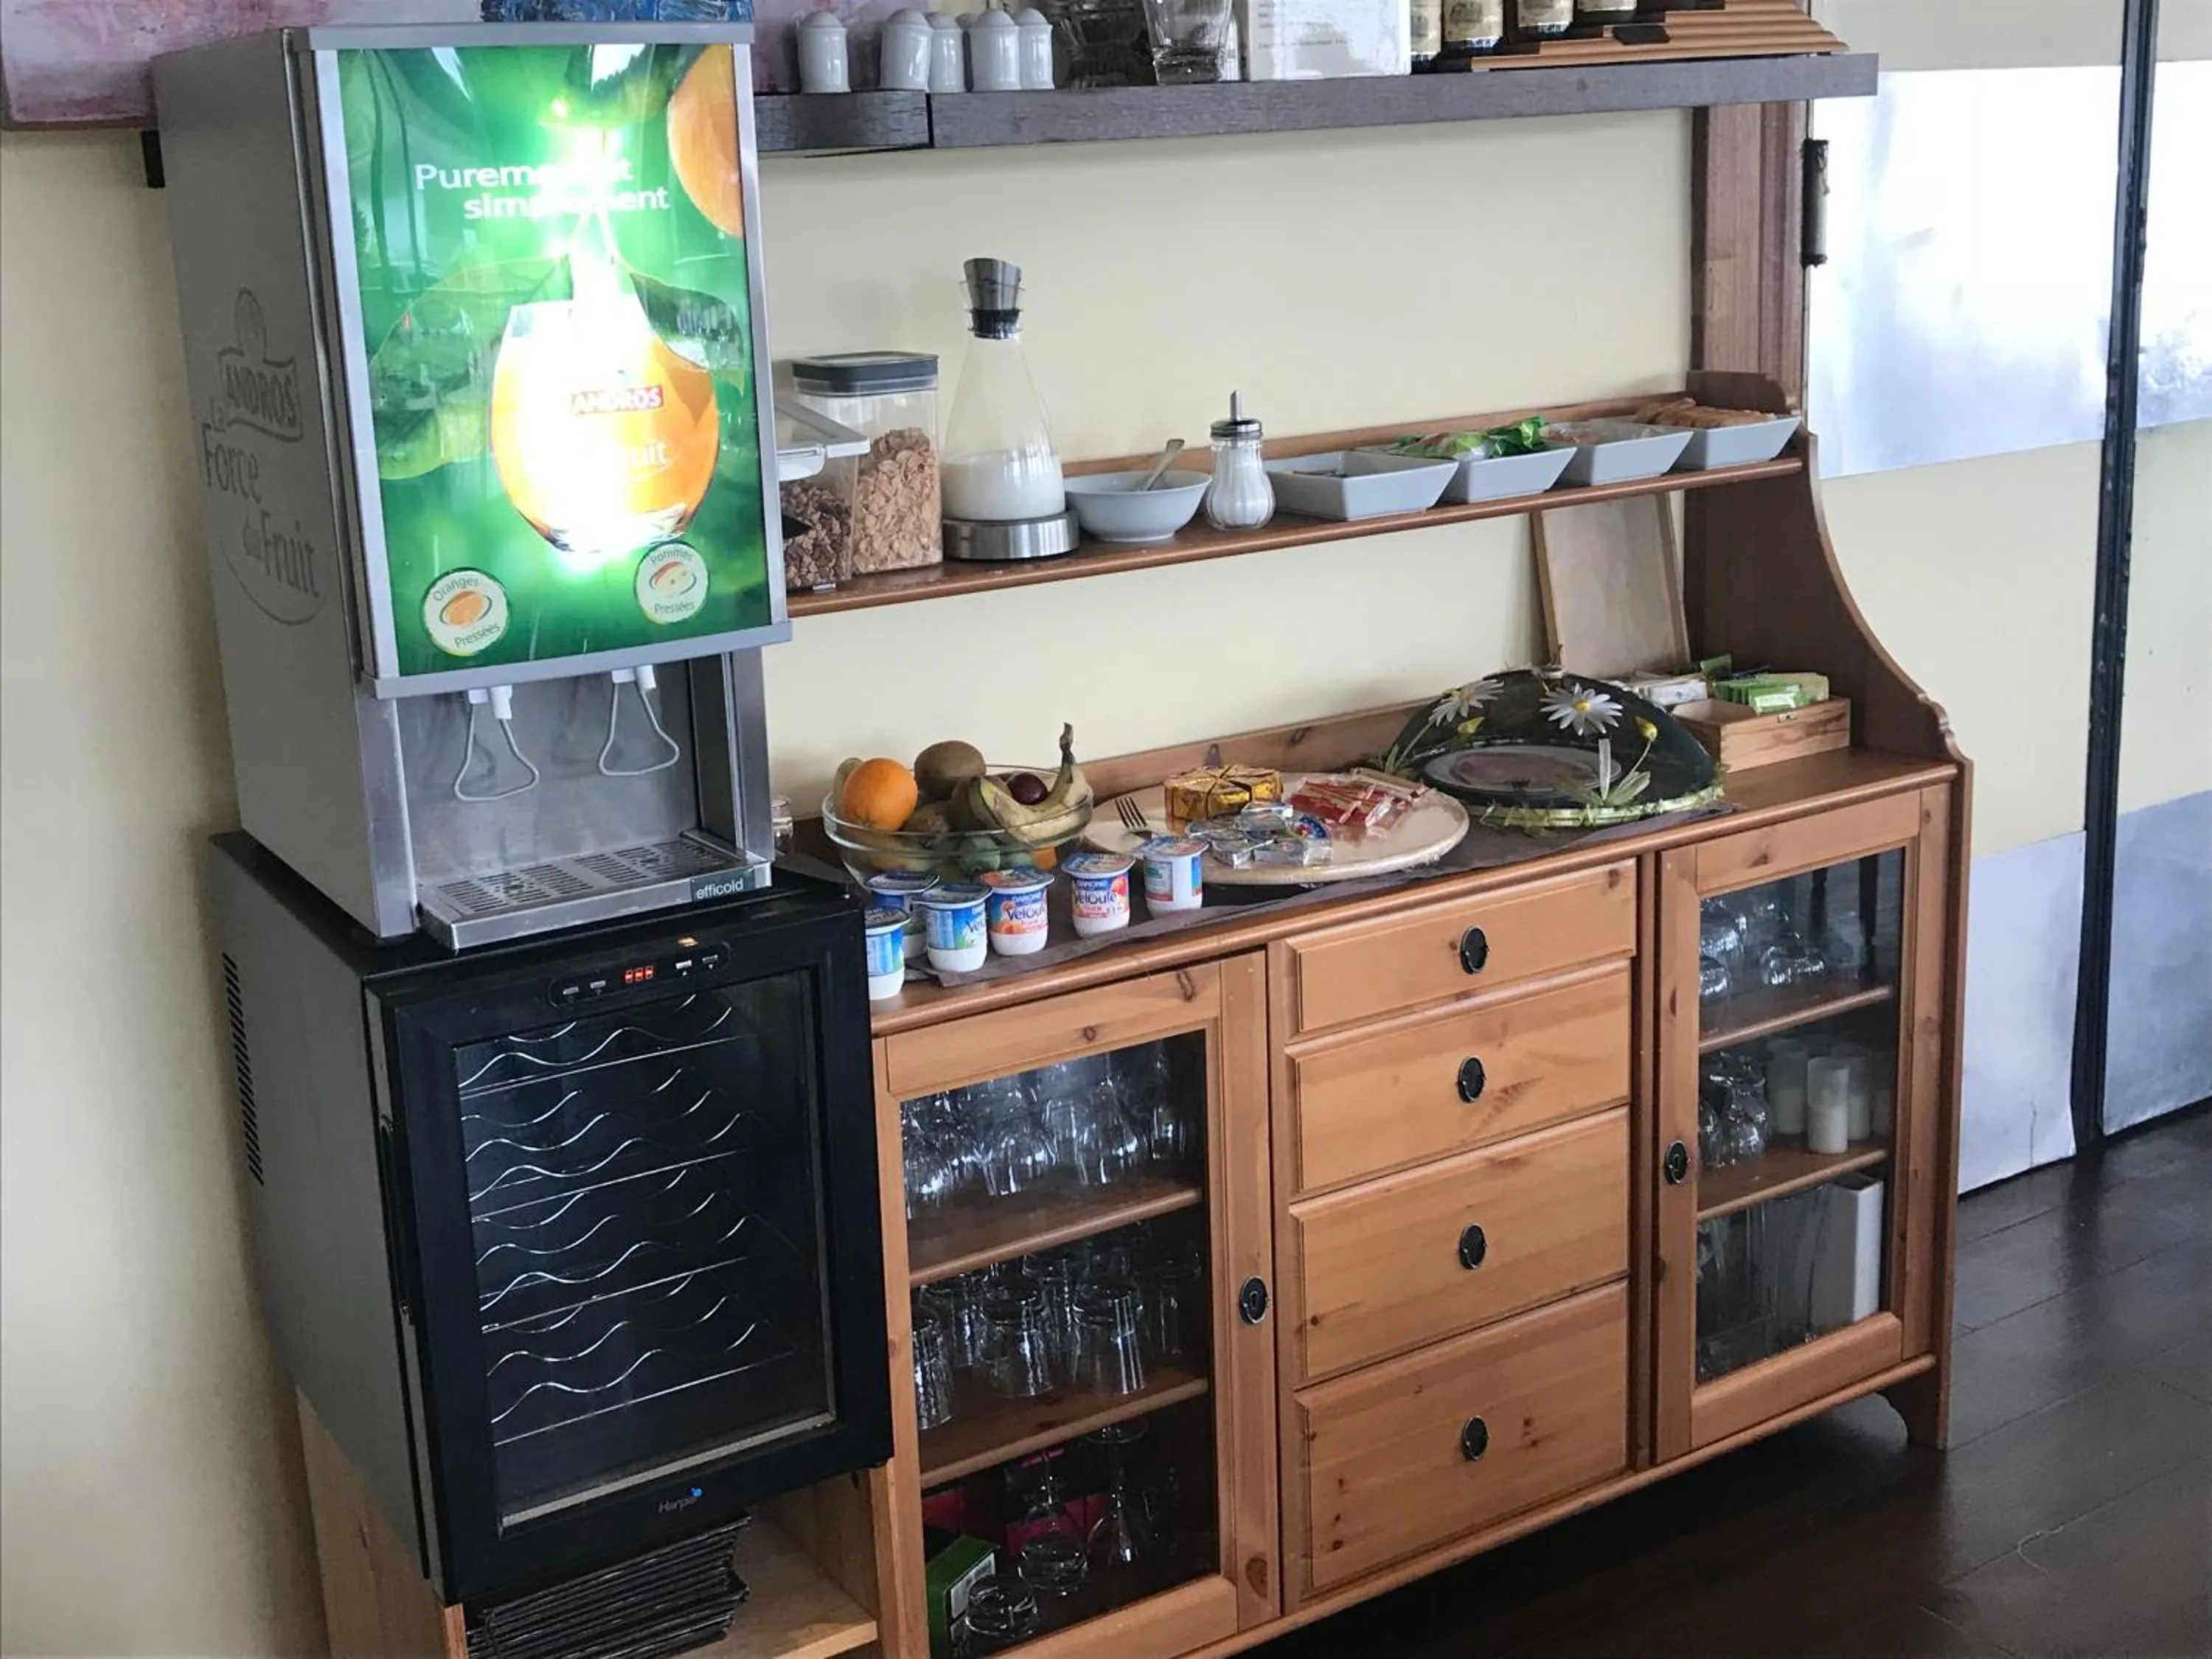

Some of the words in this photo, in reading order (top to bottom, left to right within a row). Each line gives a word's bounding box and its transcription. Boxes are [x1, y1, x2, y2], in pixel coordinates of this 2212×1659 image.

[201, 422, 260, 504] Force
[261, 509, 319, 599] Fruit
[432, 577, 479, 602] Oranges
[696, 877, 744, 900] efficold
